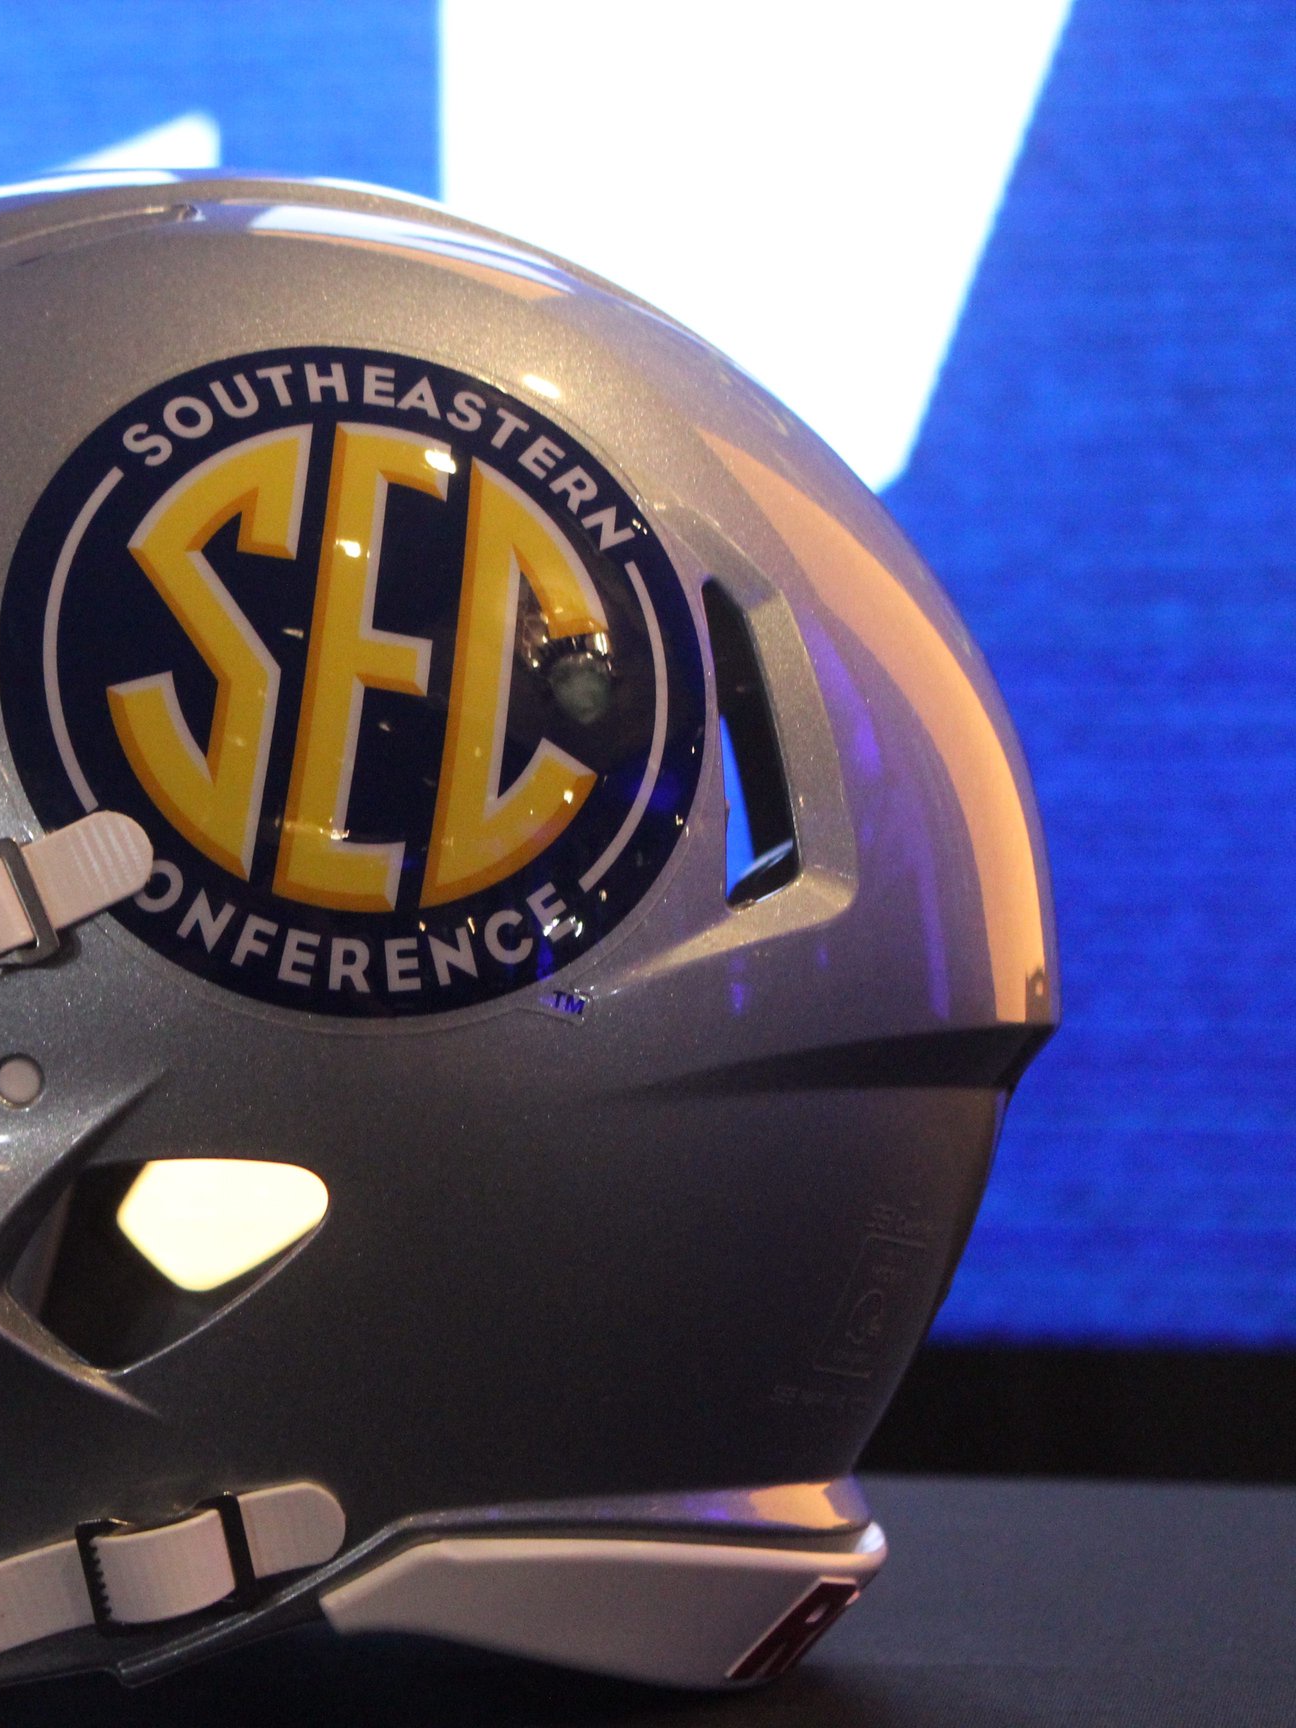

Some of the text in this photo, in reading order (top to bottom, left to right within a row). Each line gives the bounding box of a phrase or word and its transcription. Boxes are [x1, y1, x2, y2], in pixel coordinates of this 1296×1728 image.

[121, 362, 635, 551] SOUTHEASTERN
[106, 421, 609, 914] SEC
[132, 858, 577, 994] ONFERENCE
[552, 989, 586, 1016] TM
